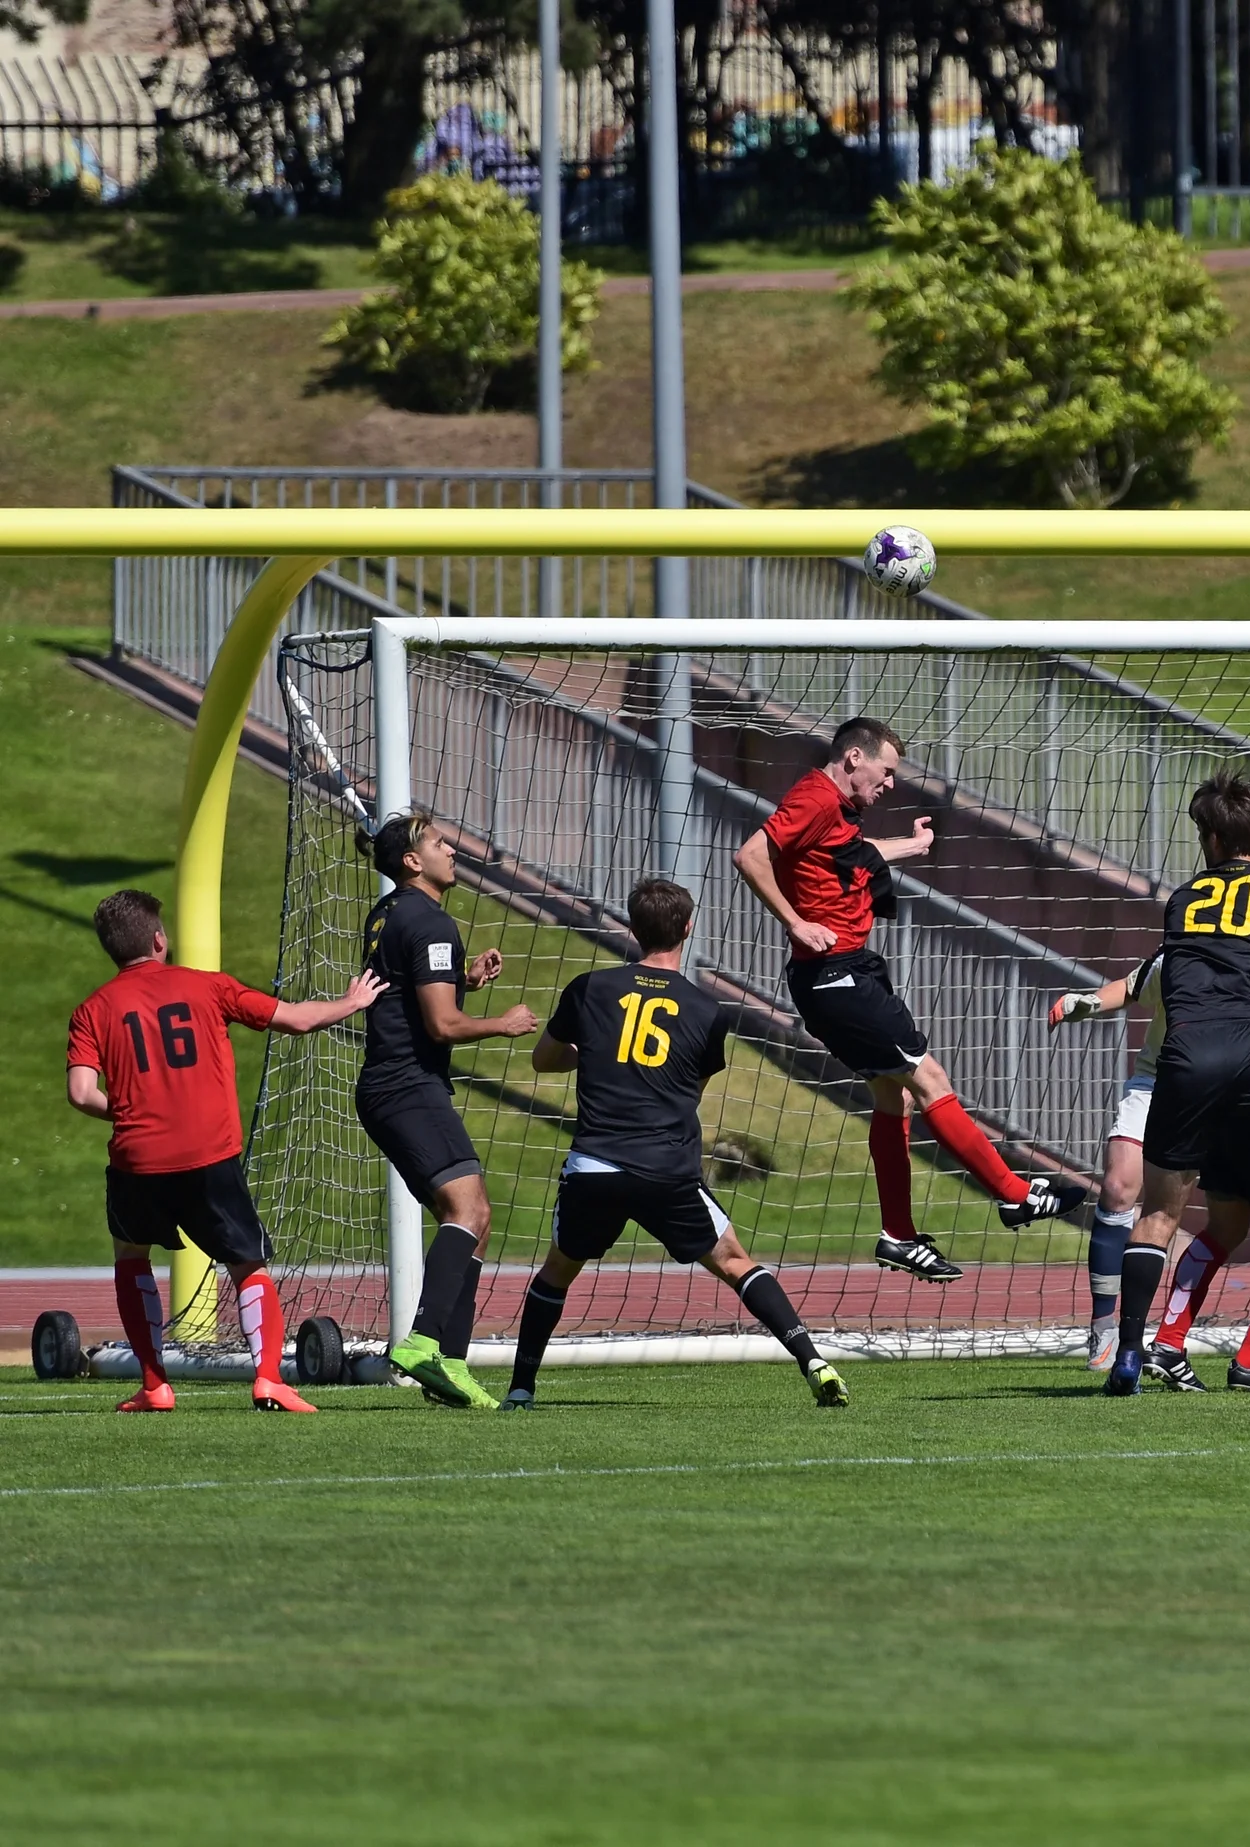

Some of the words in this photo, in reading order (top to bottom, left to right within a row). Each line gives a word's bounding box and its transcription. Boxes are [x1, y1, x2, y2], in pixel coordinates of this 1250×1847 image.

[886, 566, 908, 594] mitre
[122, 1001, 199, 1074] 16
[617, 991, 680, 1069] 16
